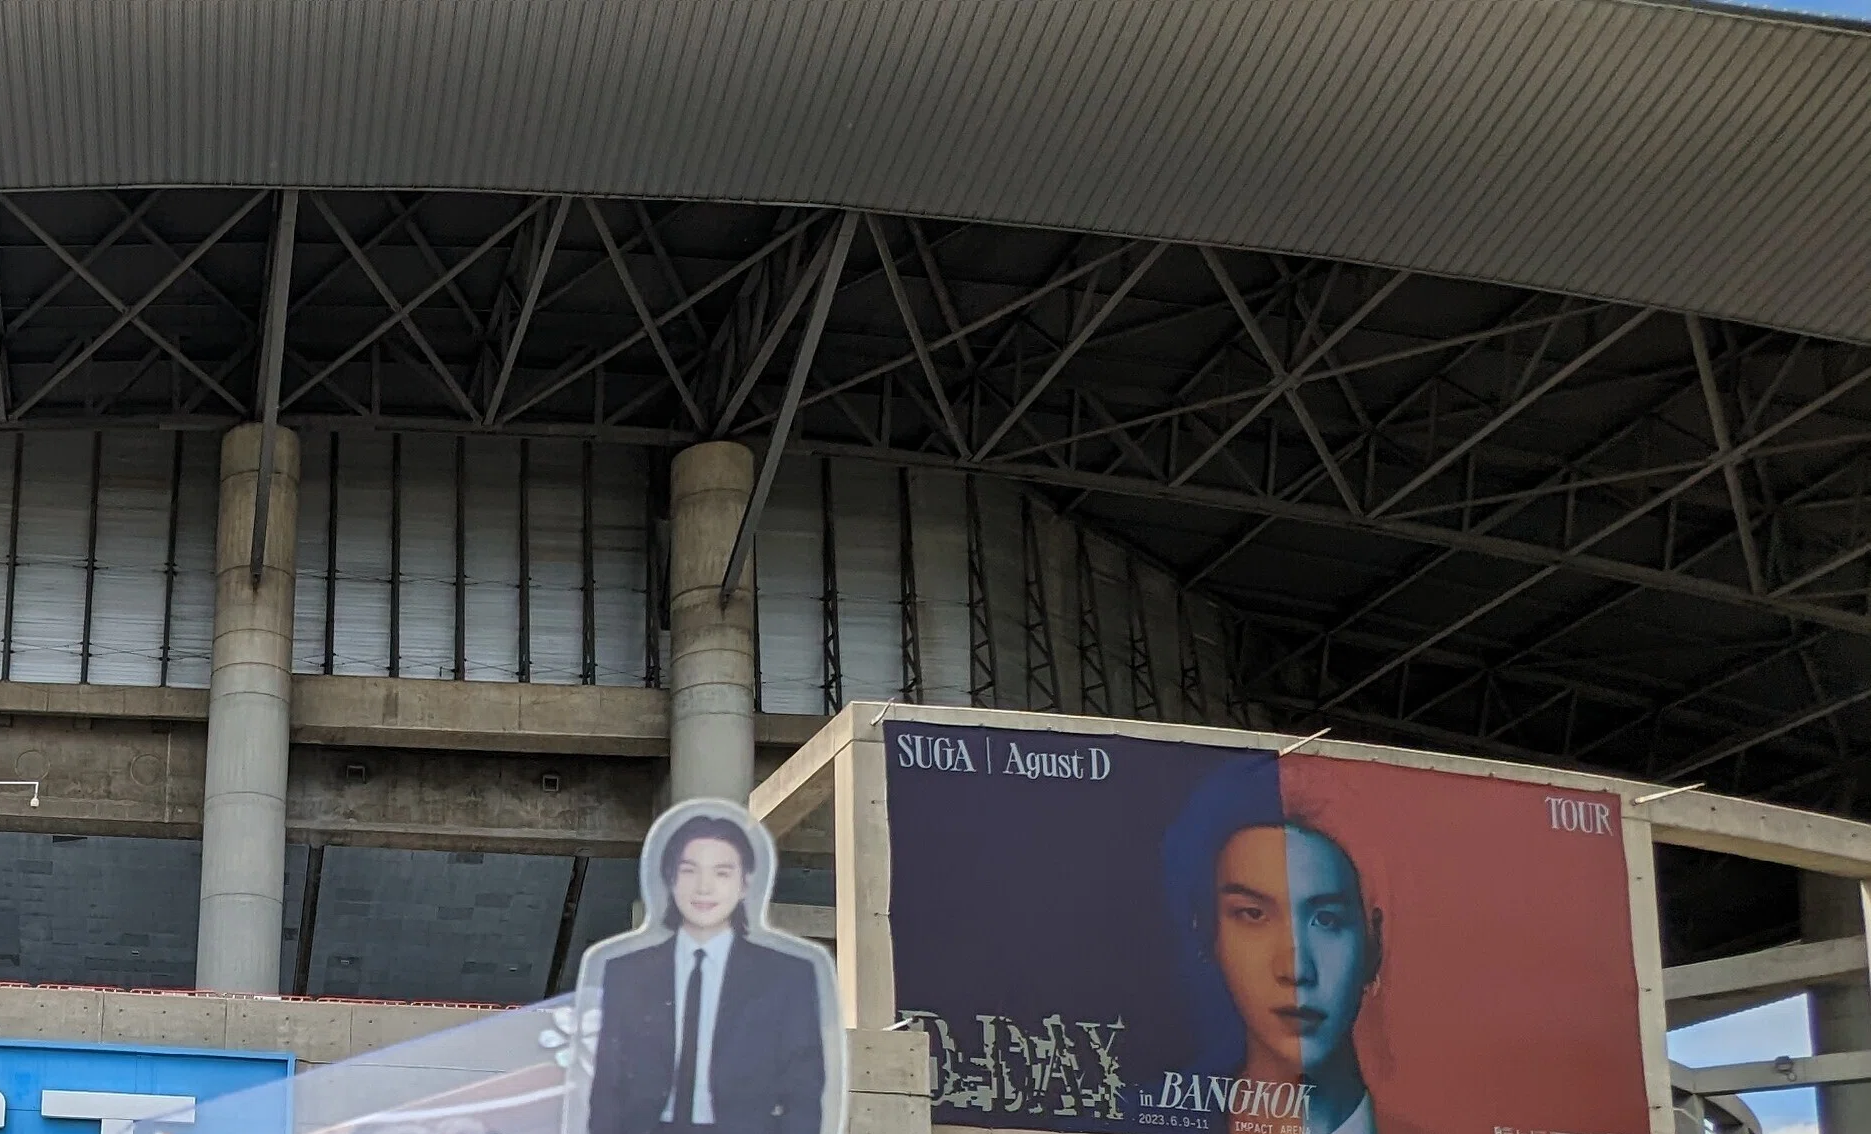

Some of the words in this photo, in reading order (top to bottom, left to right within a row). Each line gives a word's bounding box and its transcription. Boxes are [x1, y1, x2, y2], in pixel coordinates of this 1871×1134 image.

[897, 734, 976, 773] SUGA
[1003, 742, 1084, 780] Agust
[1089, 747, 1111, 780] D
[1544, 796, 1614, 836] TOUR
[1139, 1088, 1154, 1108] in
[1156, 1070, 1318, 1121] BANGKOK
[1138, 1112, 1210, 1130] 2023.6.9-11
